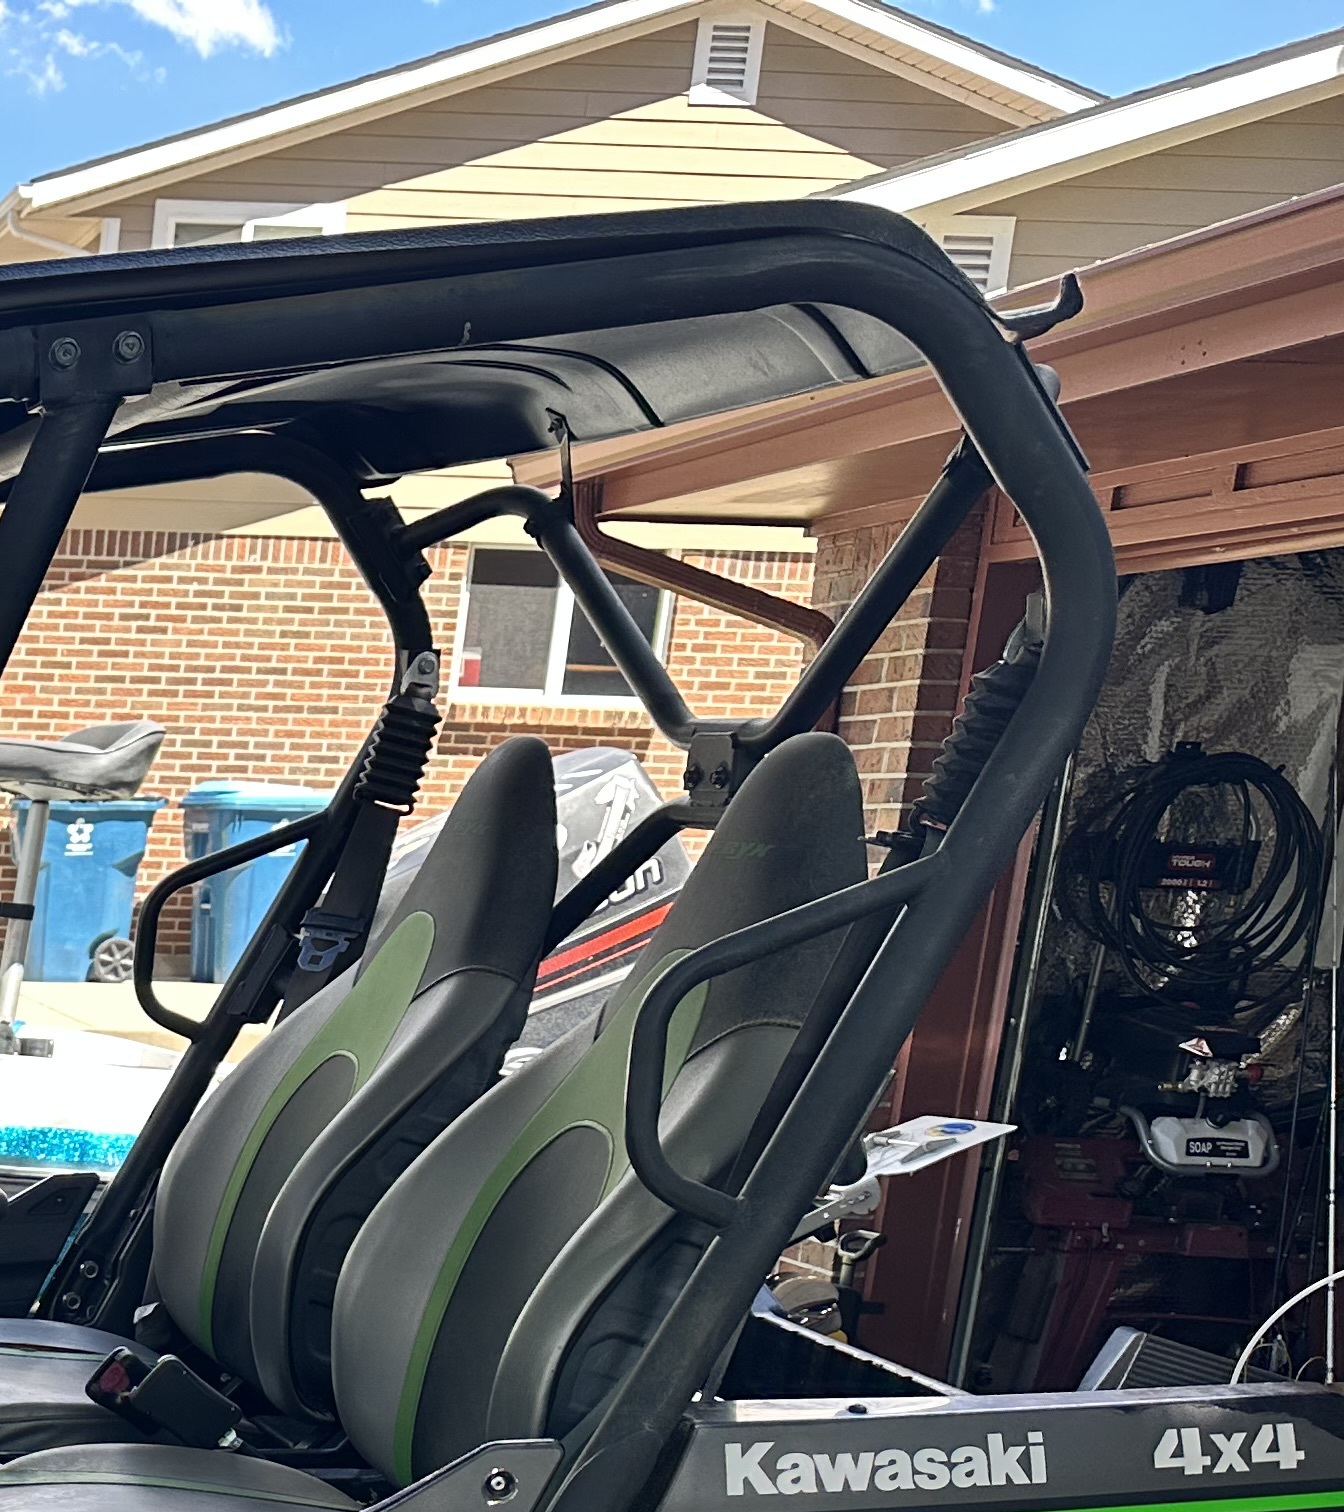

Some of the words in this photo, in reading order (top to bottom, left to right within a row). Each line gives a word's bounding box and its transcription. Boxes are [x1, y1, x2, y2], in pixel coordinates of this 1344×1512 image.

[1172, 859, 1212, 868] TOUGH
[1188, 1141, 1212, 1153] SOAP
[723, 1430, 1049, 1496] Kawasaki
[1153, 1422, 1306, 1476] 4x4
